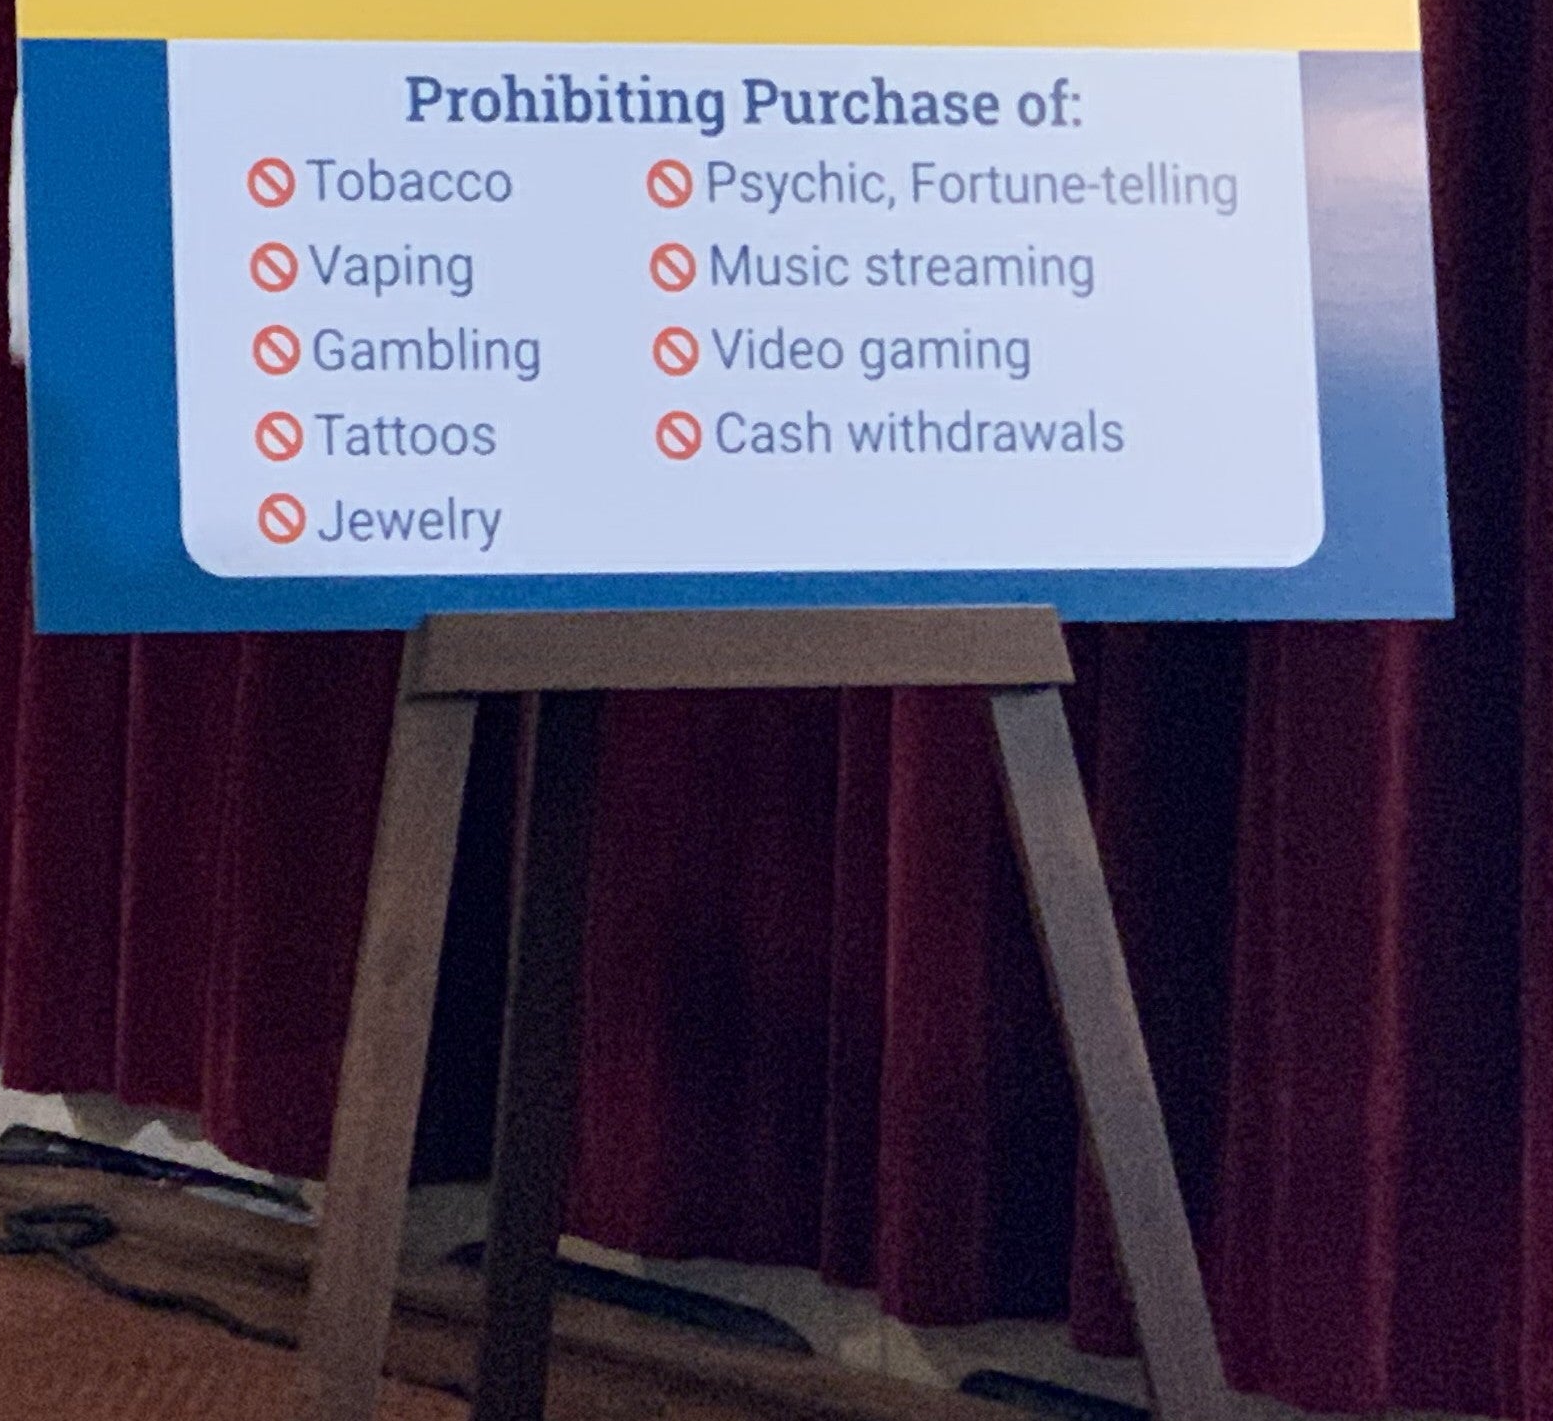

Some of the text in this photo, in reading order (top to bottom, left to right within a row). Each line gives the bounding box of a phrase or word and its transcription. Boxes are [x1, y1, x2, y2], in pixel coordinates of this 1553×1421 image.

[405, 73, 1082, 138] Prohibiting Purchase of:
[305, 157, 513, 203] Tobacco
[707, 159, 1237, 216] Psychic, Fortune-telling
[308, 243, 473, 298] Vaping
[710, 243, 1094, 299] Music streaming
[313, 326, 540, 382] Gambling
[711, 326, 1031, 382] Video gaming
[314, 413, 497, 457] Tattoos
[715, 408, 1124, 454] Cash withdrawals
[317, 496, 502, 553] Jewelry
